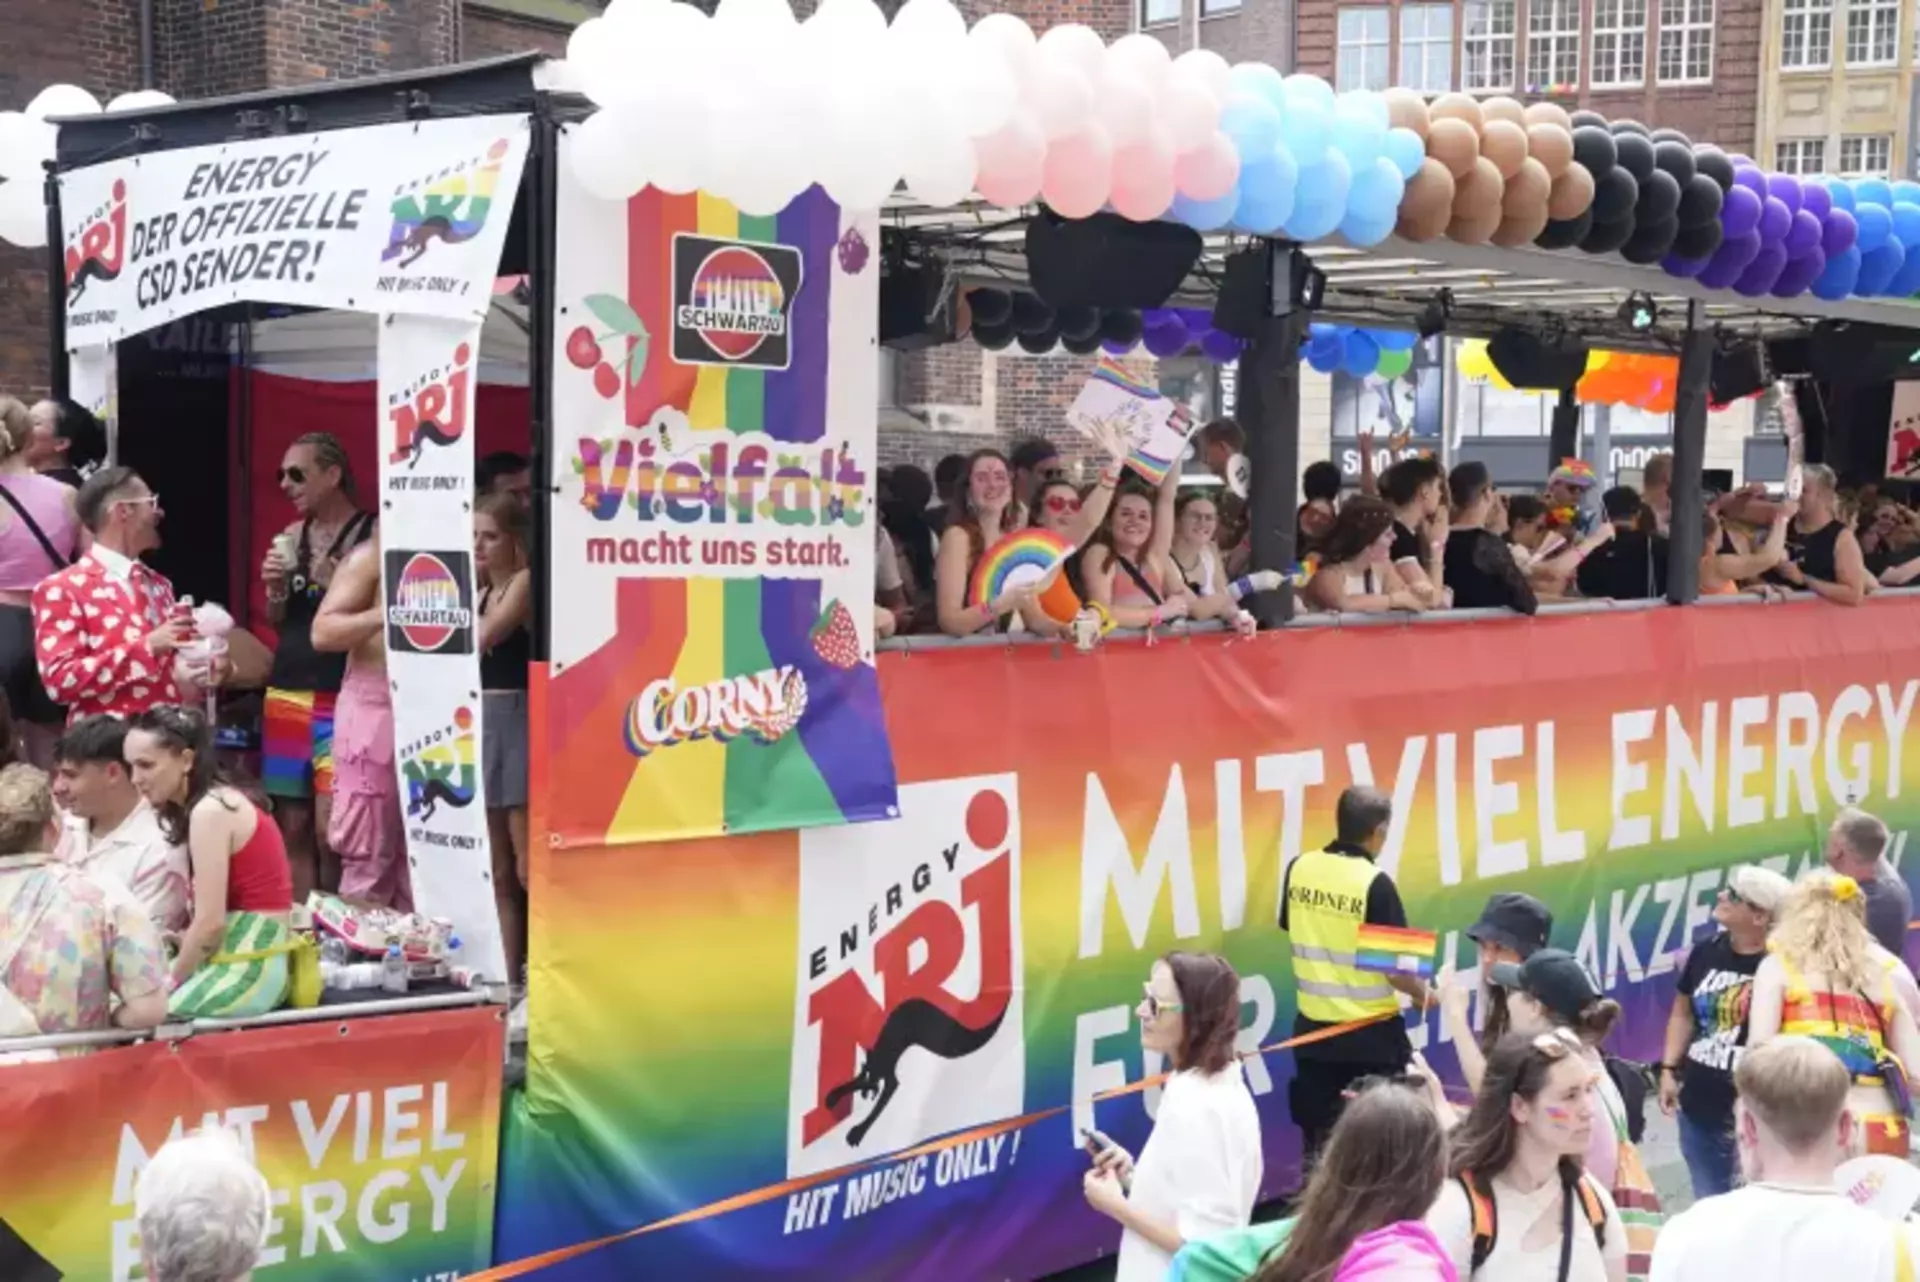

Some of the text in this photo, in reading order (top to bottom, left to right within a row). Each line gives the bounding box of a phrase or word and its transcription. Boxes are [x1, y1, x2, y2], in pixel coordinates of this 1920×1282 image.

[183, 150, 331, 200] ENERGY
[130, 188, 368, 263] DER OFFIZIELLE
[137, 240, 326, 310] CSD SENDER!
[578, 437, 866, 528] Vielfalt
[586, 531, 850, 567] macht uns stark.
[1078, 679, 1920, 960] MIT VIEL ENERGY
[808, 842, 961, 981] ENERGY
[1289, 885, 1364, 914] ORDNER
[801, 788, 1013, 1150] NRJ
[289, 1081, 466, 1171] VIEL
[783, 1183, 840, 1235] HIT
[843, 1155, 929, 1220] MUSIC
[934, 1134, 1005, 1188] ONLY
